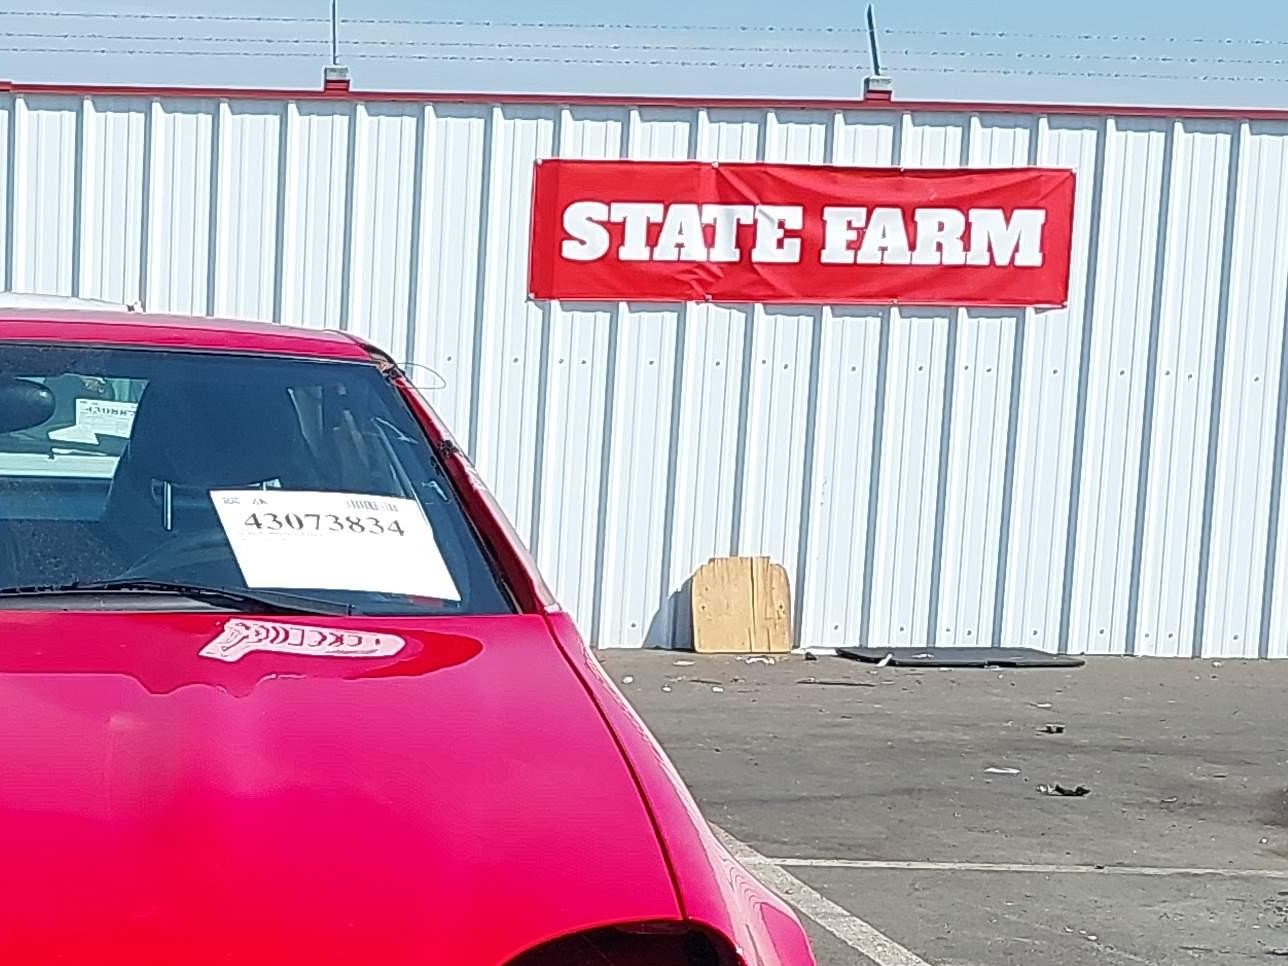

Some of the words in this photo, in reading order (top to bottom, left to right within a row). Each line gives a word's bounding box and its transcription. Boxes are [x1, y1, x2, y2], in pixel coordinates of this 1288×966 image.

[561, 201, 802, 263] STATE
[820, 206, 1046, 267] FARM
[244, 512, 405, 537] 43073834
